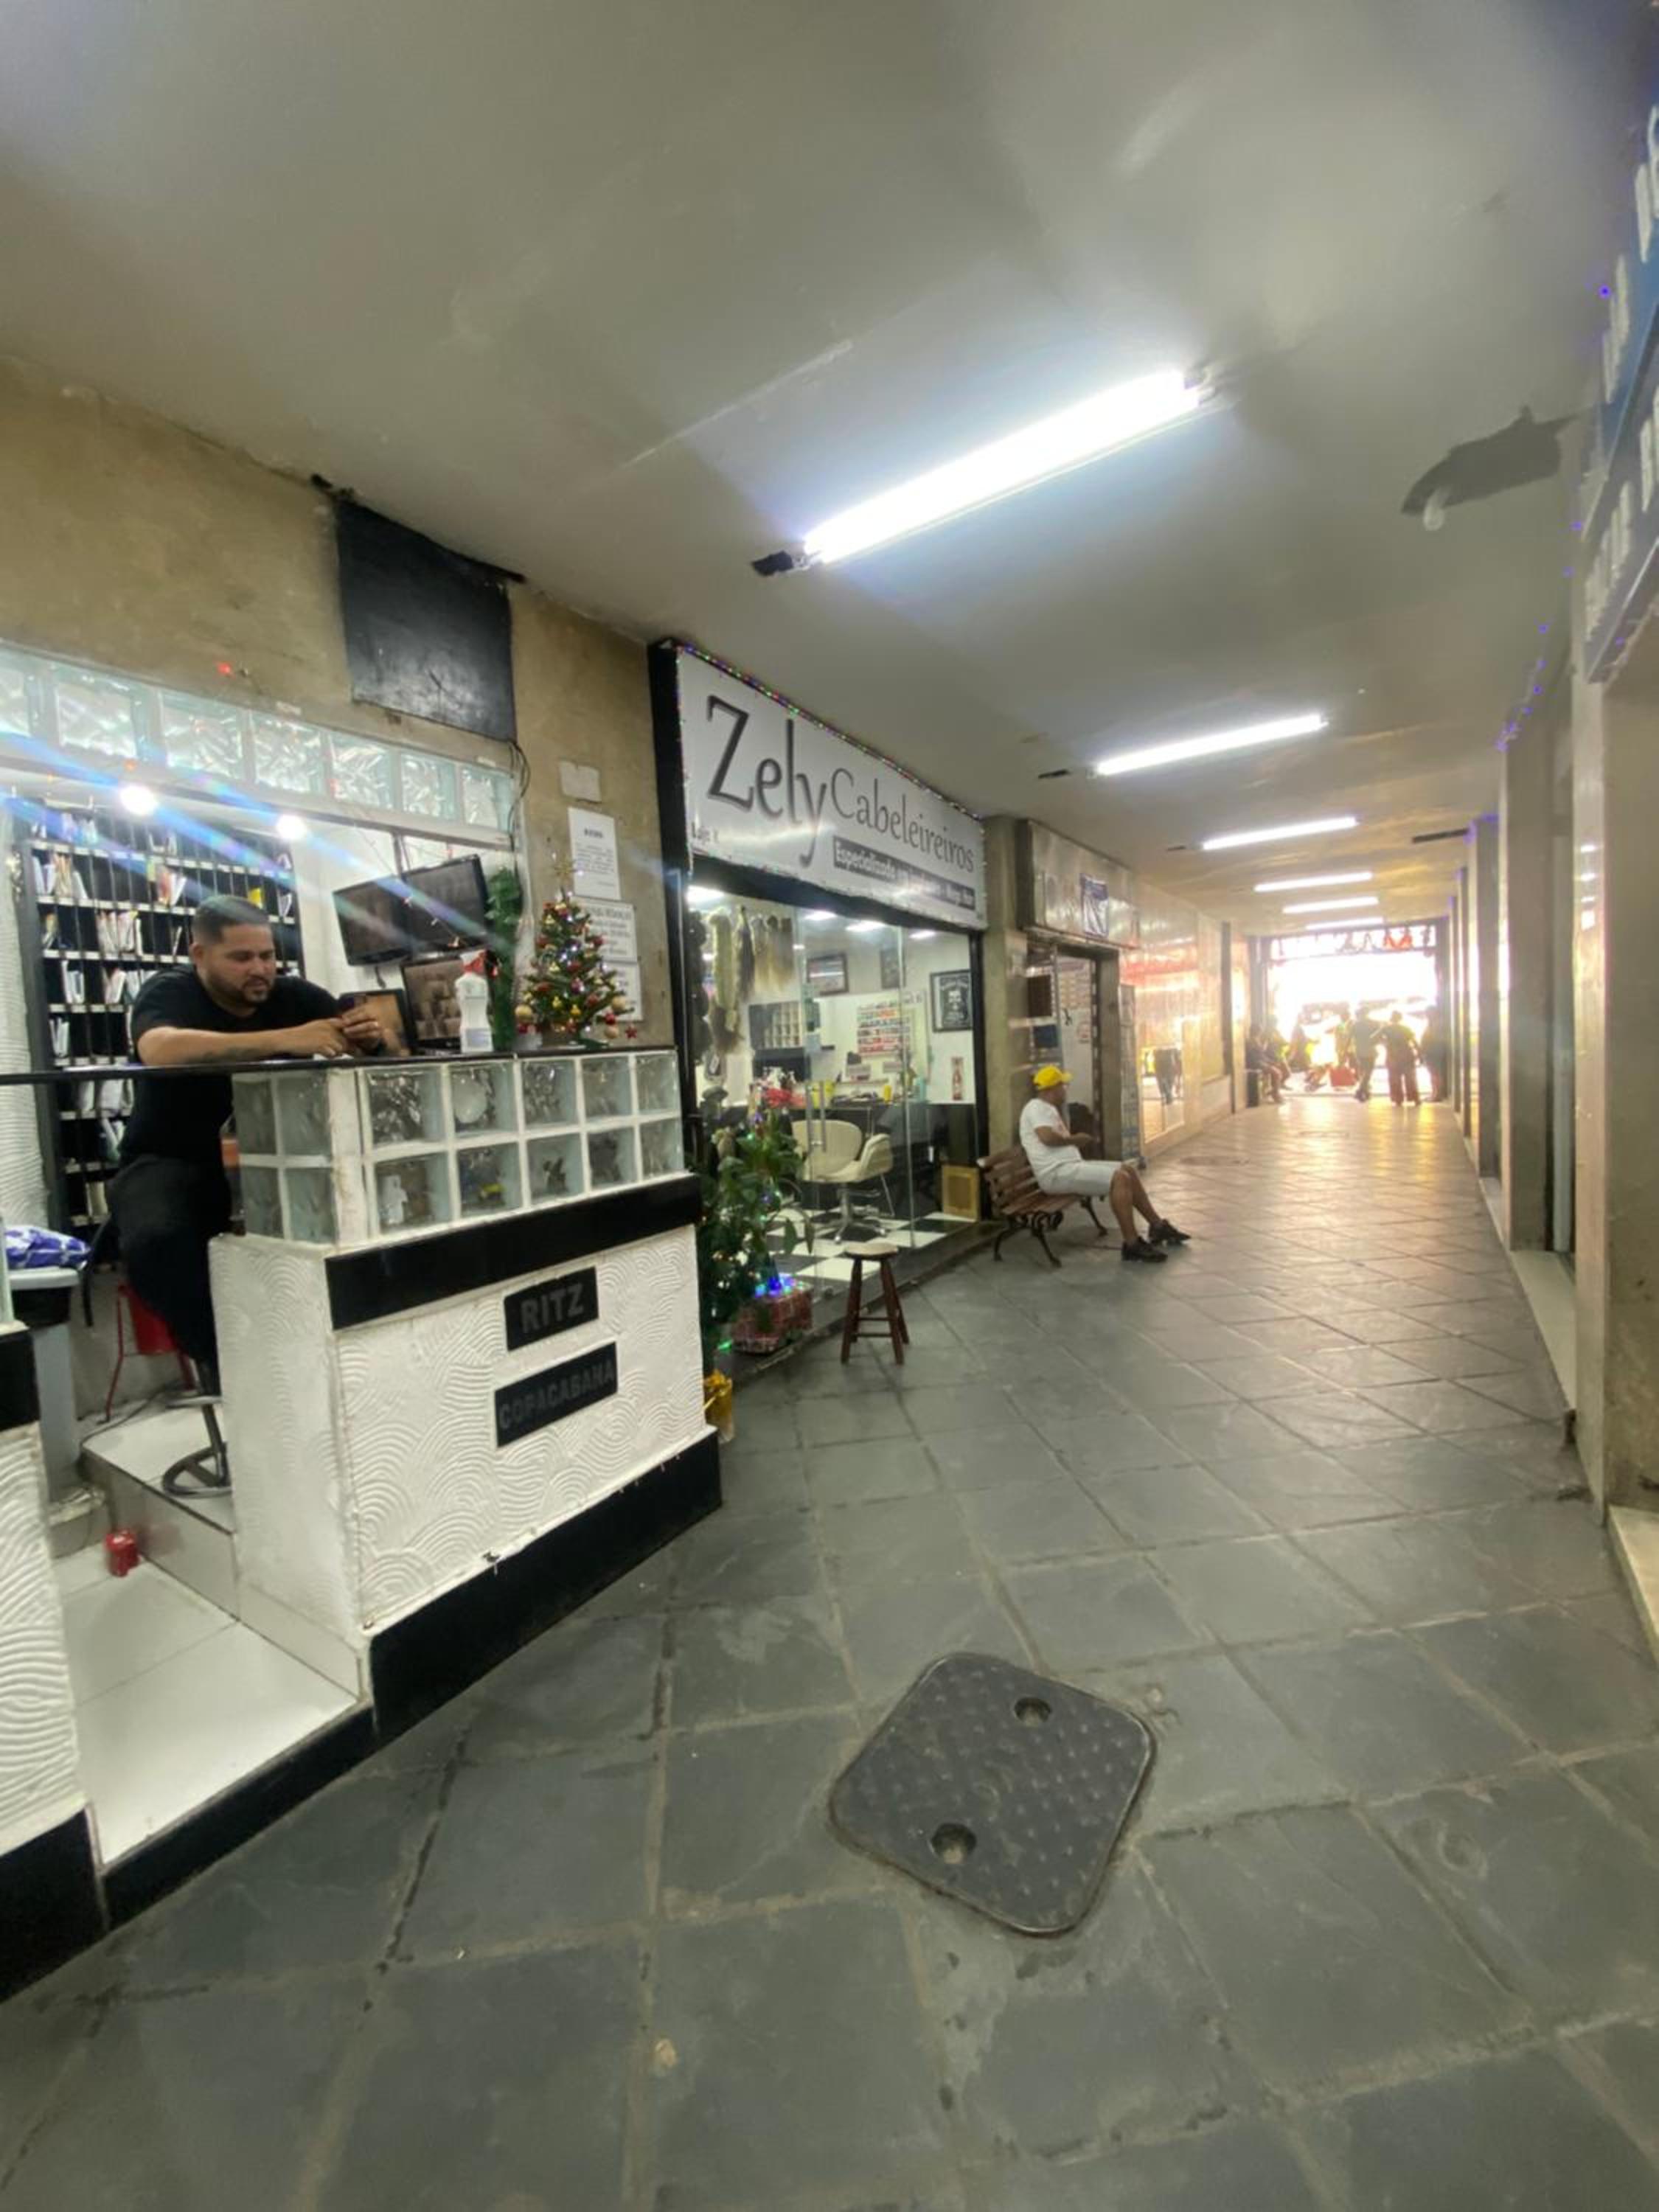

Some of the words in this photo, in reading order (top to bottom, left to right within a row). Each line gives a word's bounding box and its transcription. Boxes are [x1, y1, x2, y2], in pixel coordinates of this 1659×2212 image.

[707, 694, 827, 868] Zely
[830, 768, 975, 873] Cabeleireiros
[520, 1283, 584, 1333] RITZ
